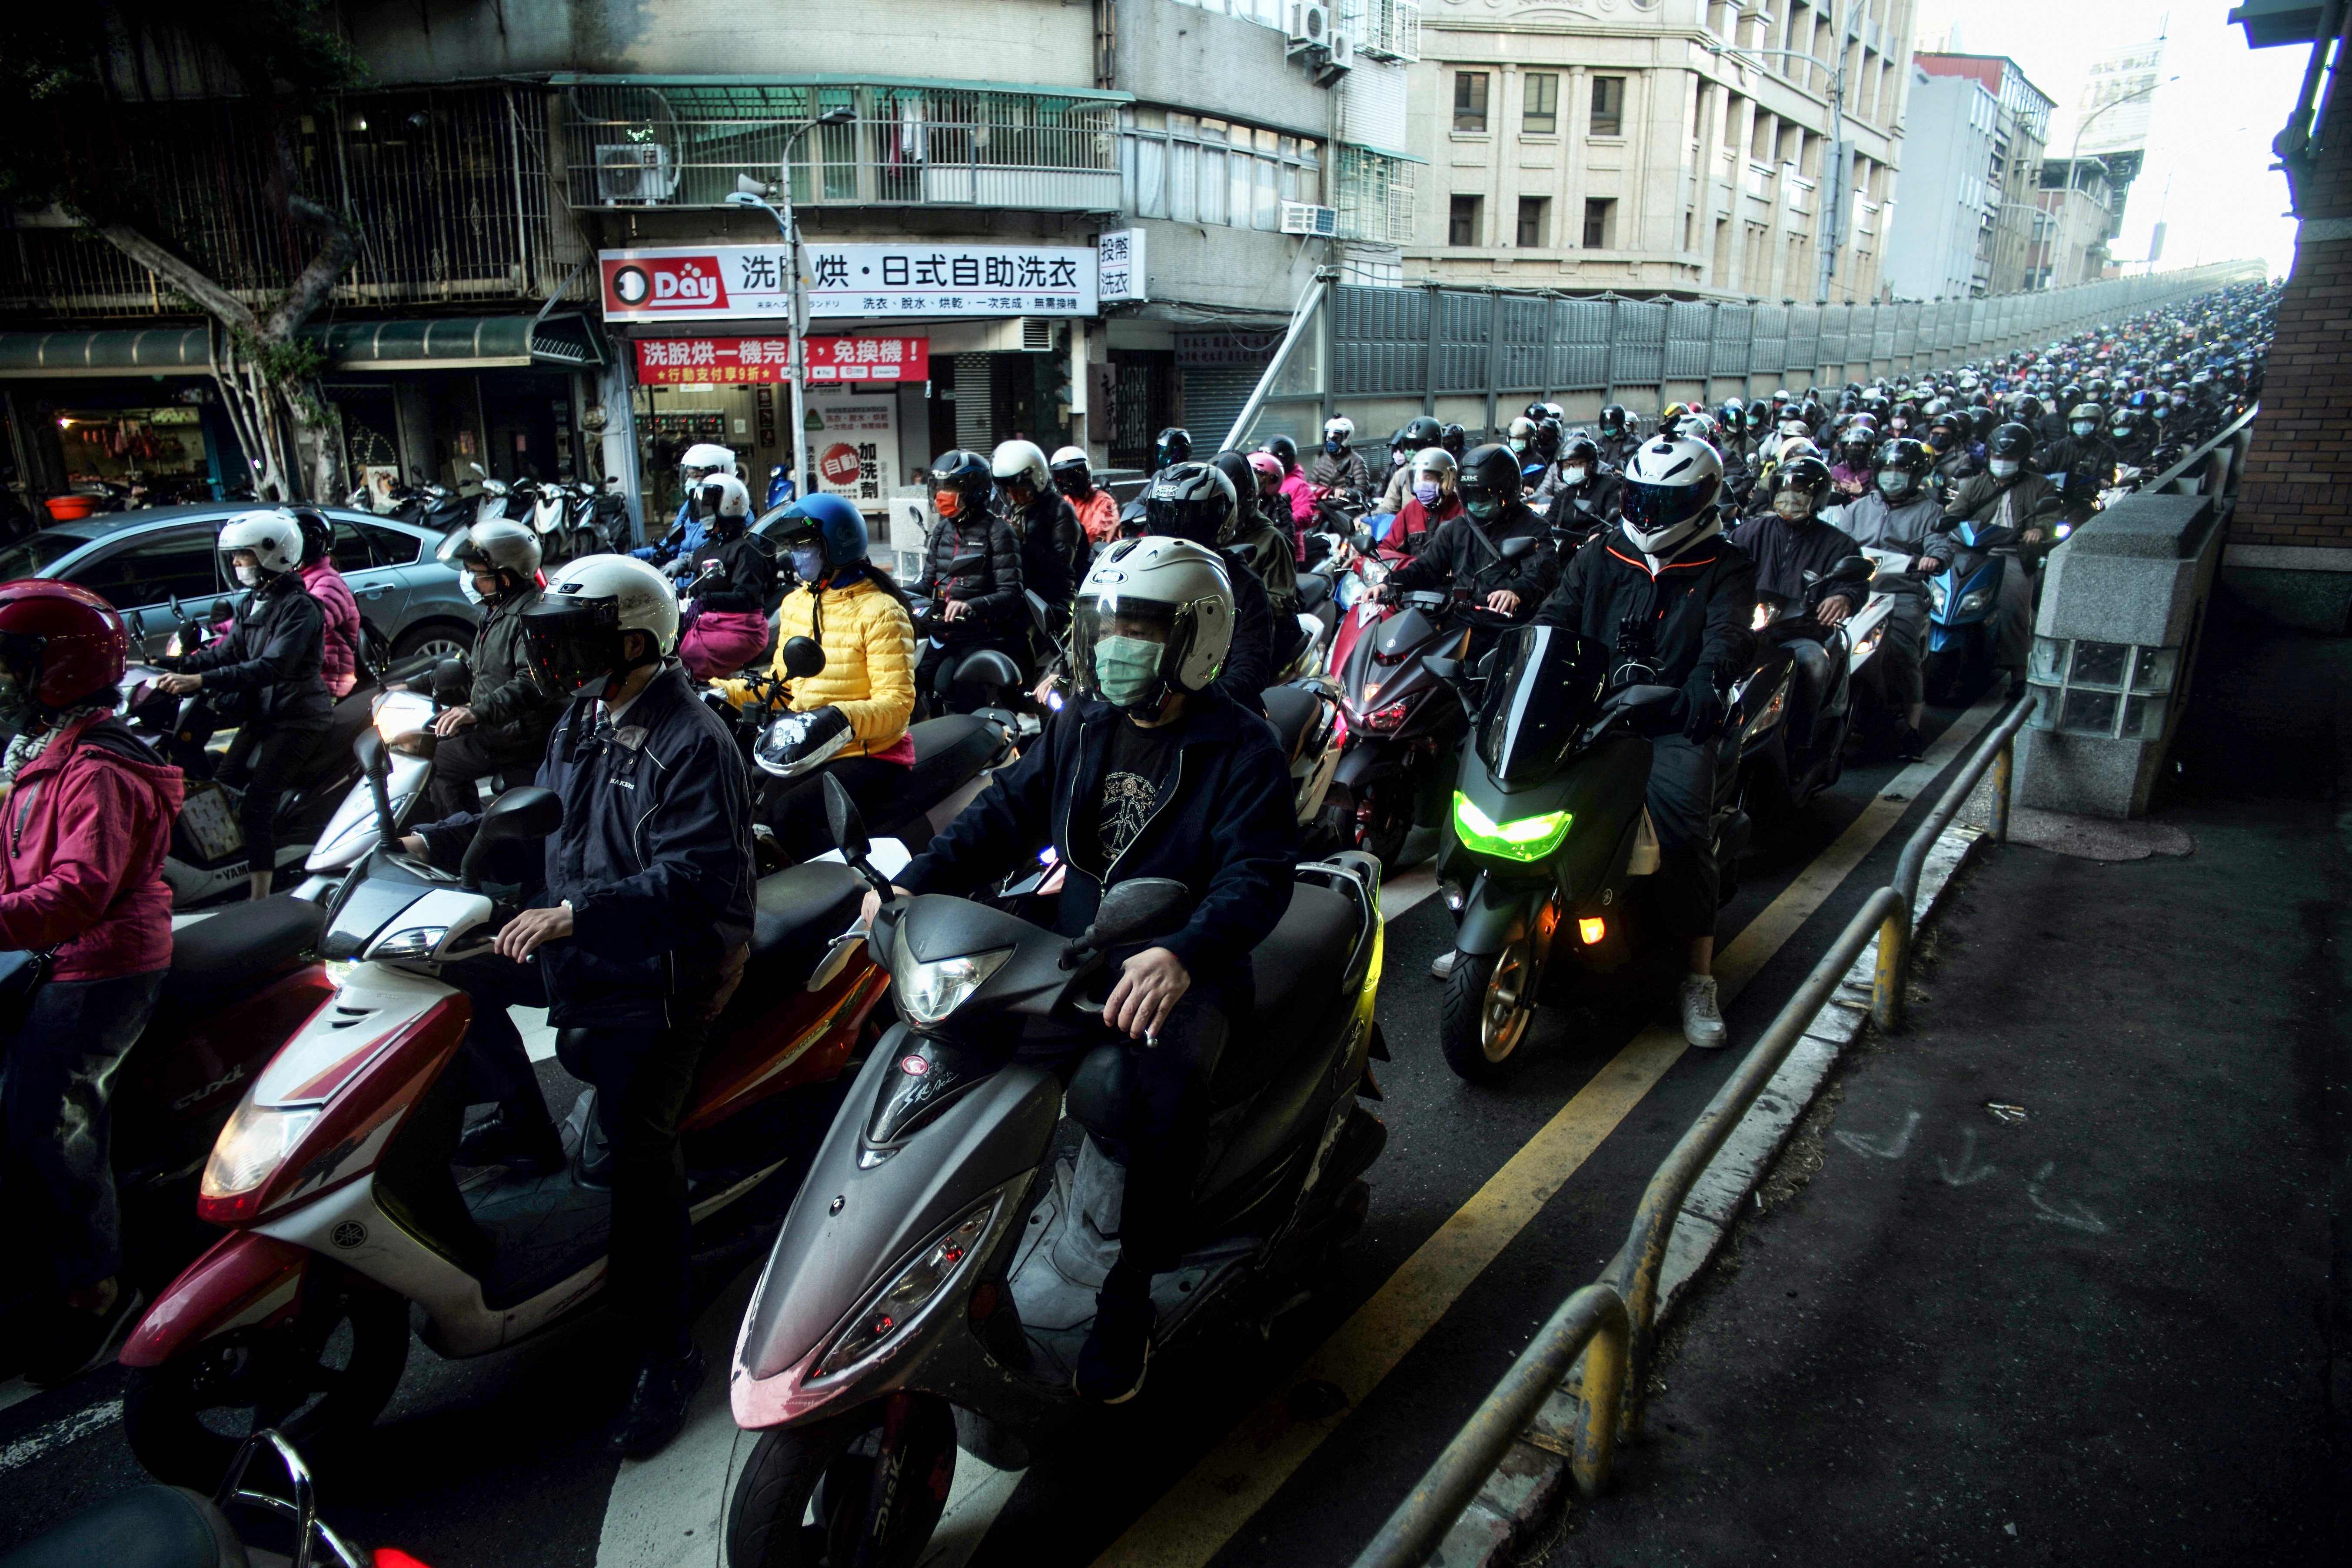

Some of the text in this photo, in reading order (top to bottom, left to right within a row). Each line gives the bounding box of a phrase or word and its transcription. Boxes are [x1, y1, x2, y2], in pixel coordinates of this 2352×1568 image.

[1101, 237, 1128, 262] 投幣
[742, 254, 1076, 289] 洗烘・日式自助洗衣
[1101, 271, 1128, 295] 洗衣
[825, 453, 858, 476] 自動
[859, 442, 878, 499] 加洗劑
